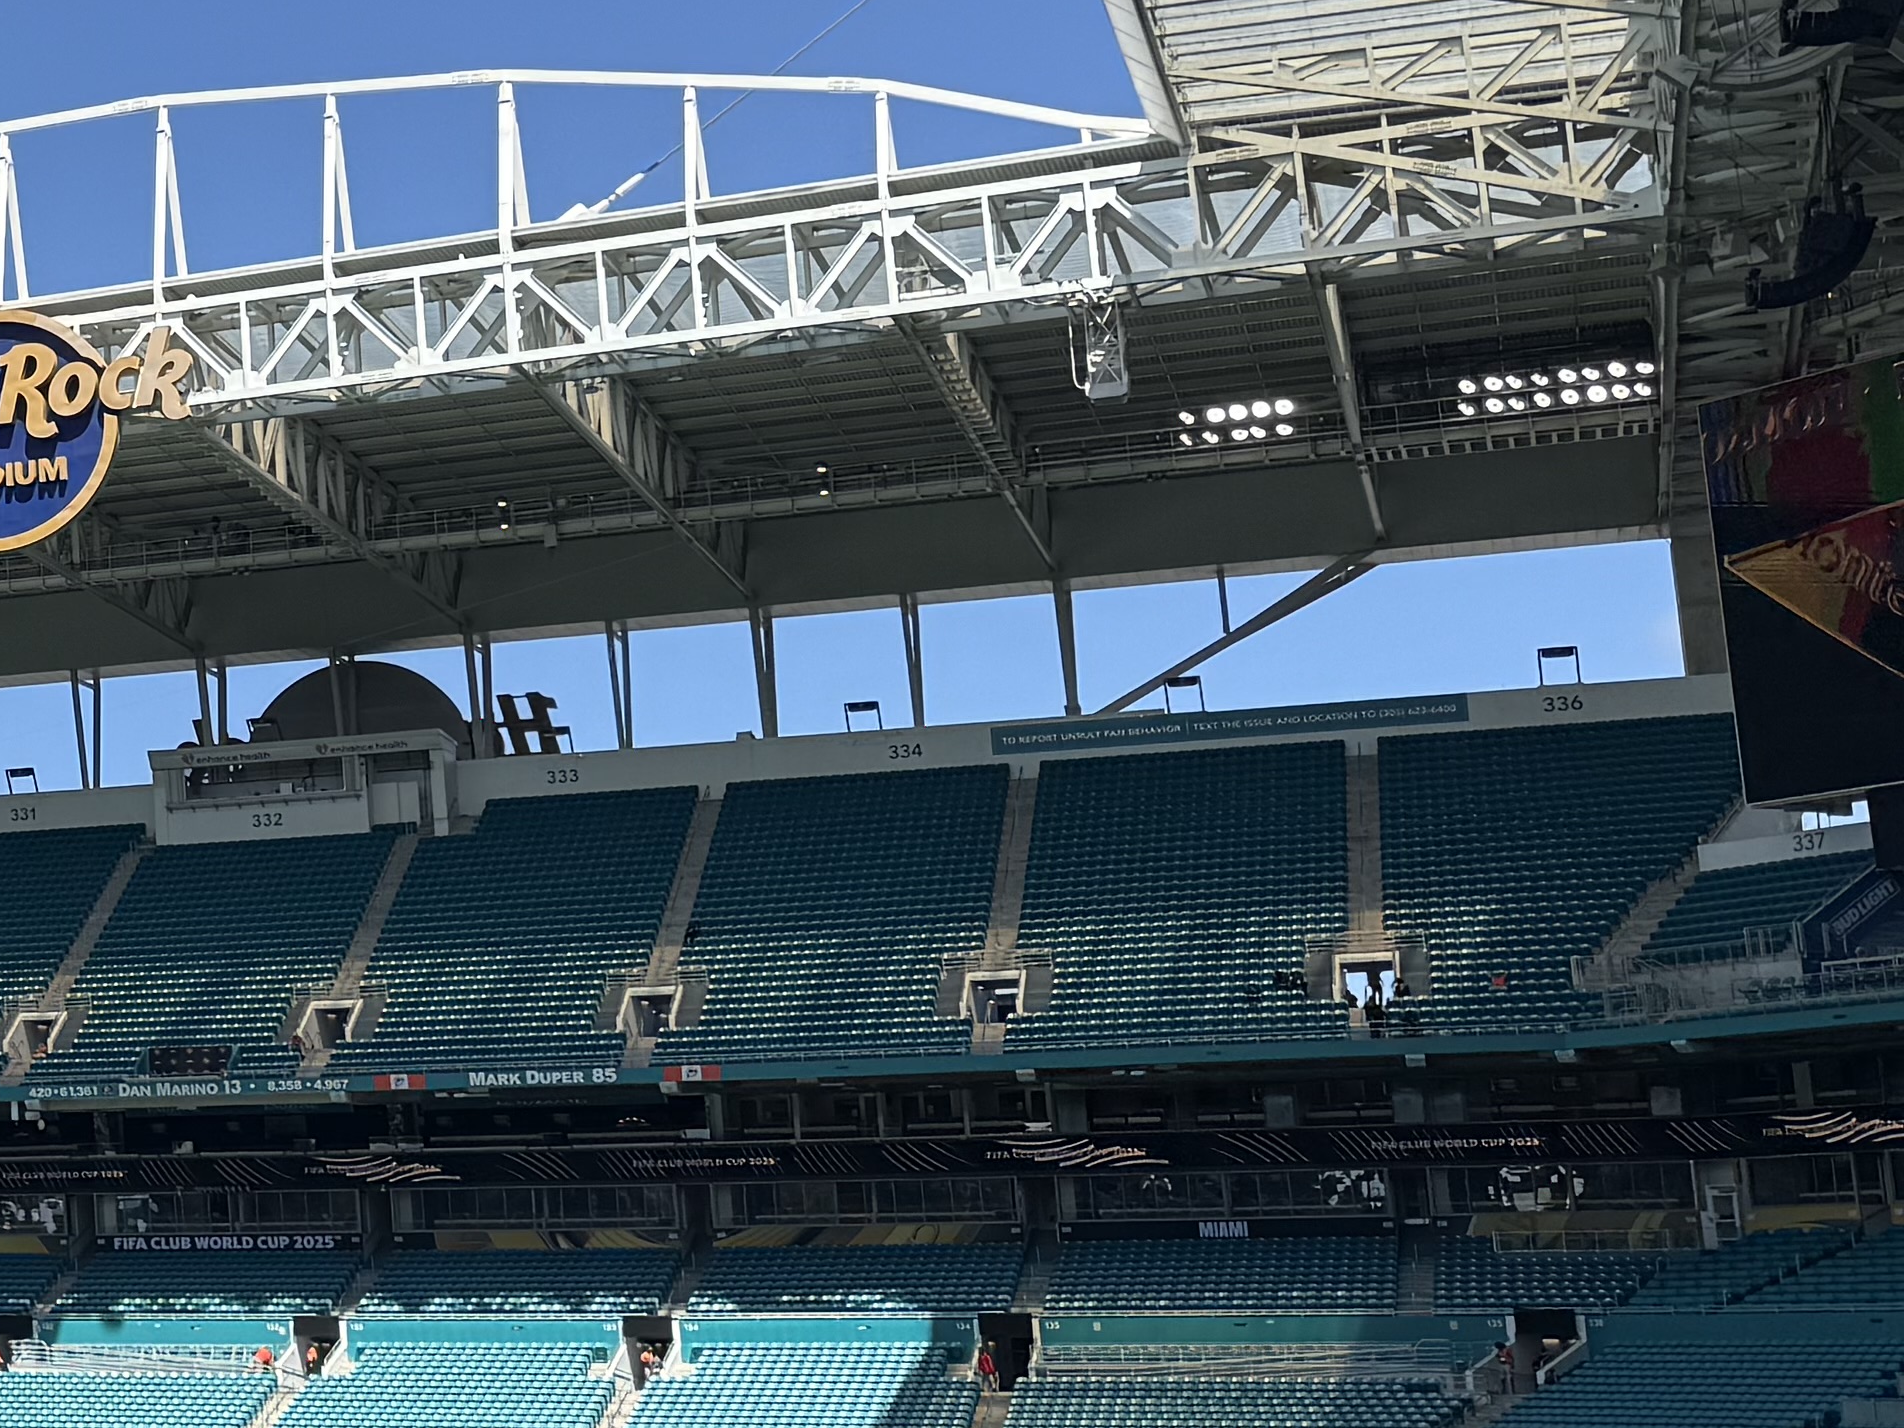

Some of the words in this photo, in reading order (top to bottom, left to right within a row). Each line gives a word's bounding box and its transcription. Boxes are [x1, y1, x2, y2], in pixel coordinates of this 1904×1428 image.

[1542, 695, 1583, 712] 336
[1303, 712, 1357, 723] LOCATION
[889, 743, 923, 759] 334
[547, 769, 579, 784] 333
[11, 807, 36, 821] 331
[252, 813, 283, 828] 332
[1792, 832, 1824, 852] 337
[1832, 907, 1860, 935] BUD
[1856, 879, 1895, 916] LIGHT
[468, 1072, 520, 1086] MARK
[526, 1071, 585, 1085] DUPER
[591, 1068, 617, 1083] 85
[118, 1083, 151, 1098] DAN
[157, 1082, 218, 1096] MARINO
[224, 1080, 242, 1094] 13
[1481, 1138, 1506, 1147] CUP
[1198, 1220, 1248, 1238] MIAMI
[113, 1236, 146, 1250] FIFA
[150, 1236, 191, 1250] CLUB
[194, 1236, 253, 1250] WORLD
[257, 1236, 290, 1250] CUP
